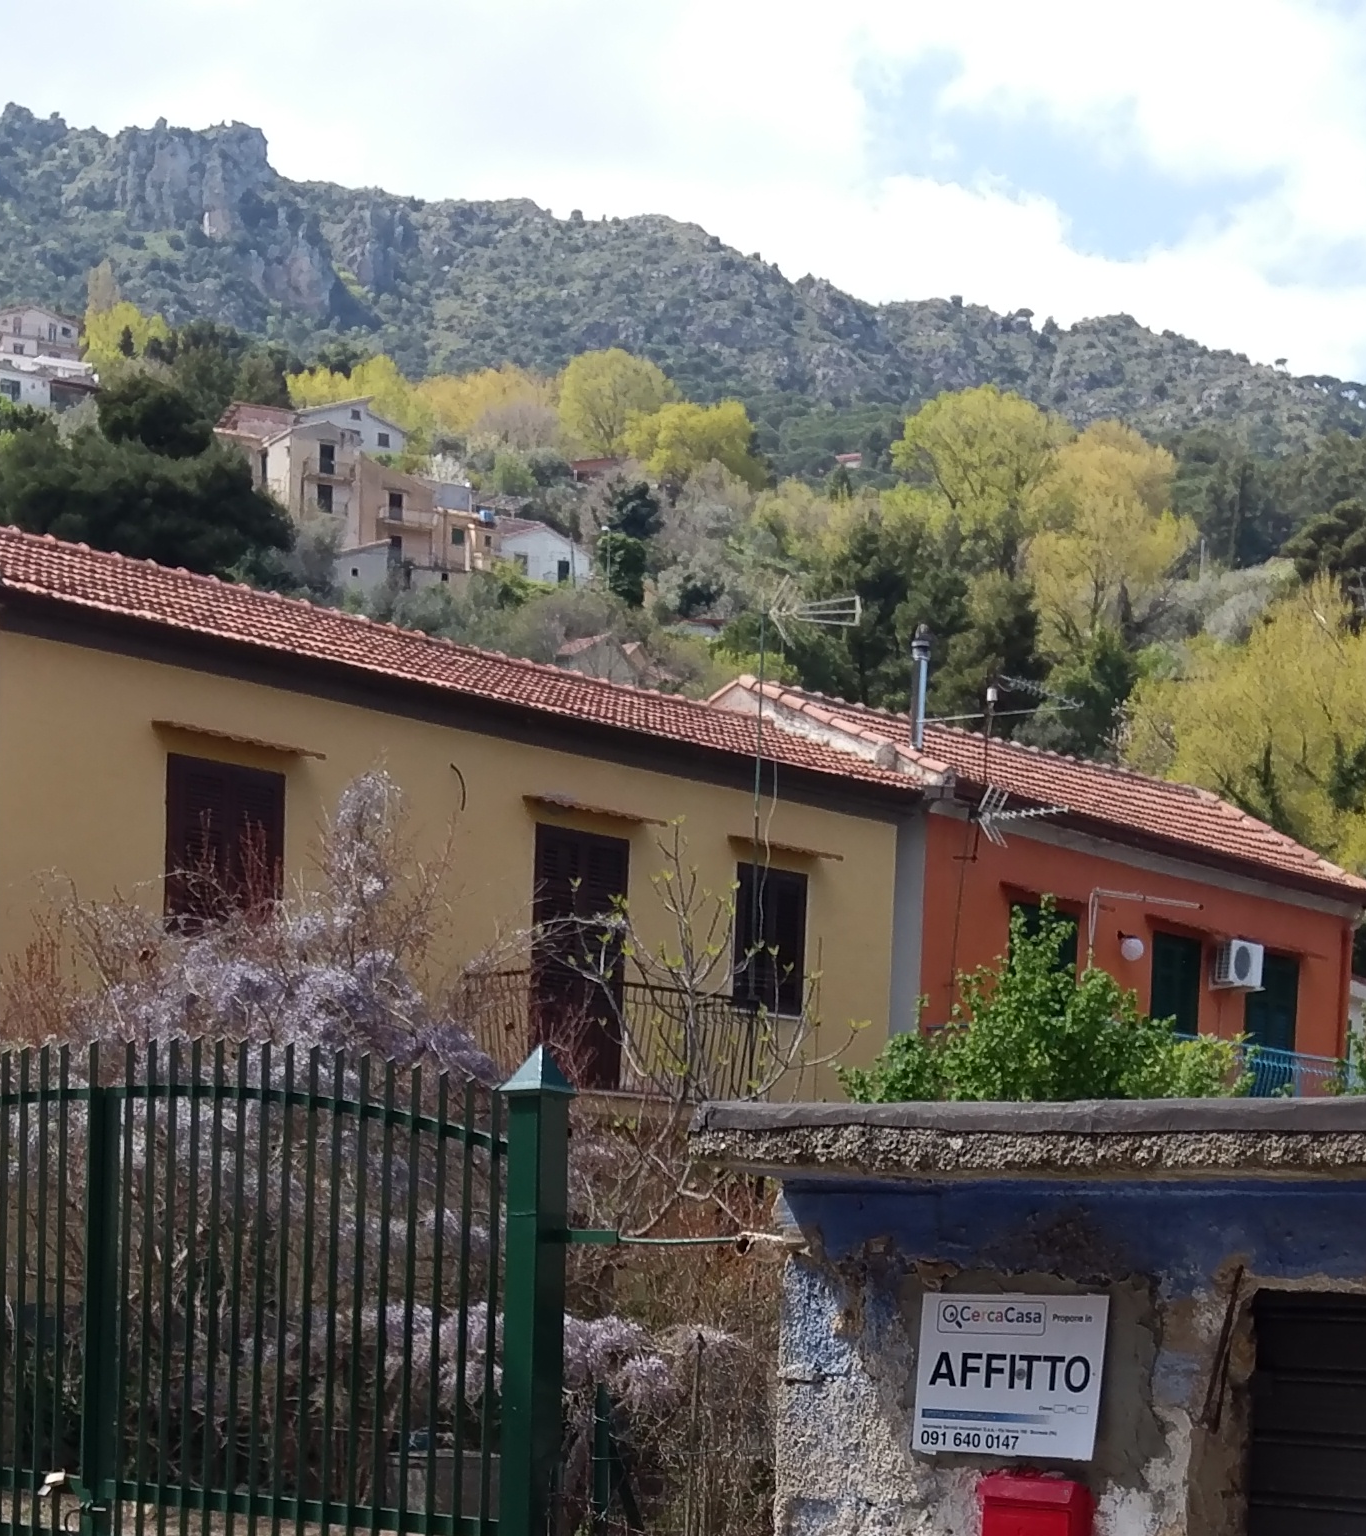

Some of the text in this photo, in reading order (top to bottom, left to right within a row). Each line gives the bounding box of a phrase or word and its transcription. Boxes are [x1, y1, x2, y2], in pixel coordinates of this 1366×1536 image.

[928, 1351, 1091, 1394] AFFITTO
[921, 1430, 1020, 1451] 091 640 0147
